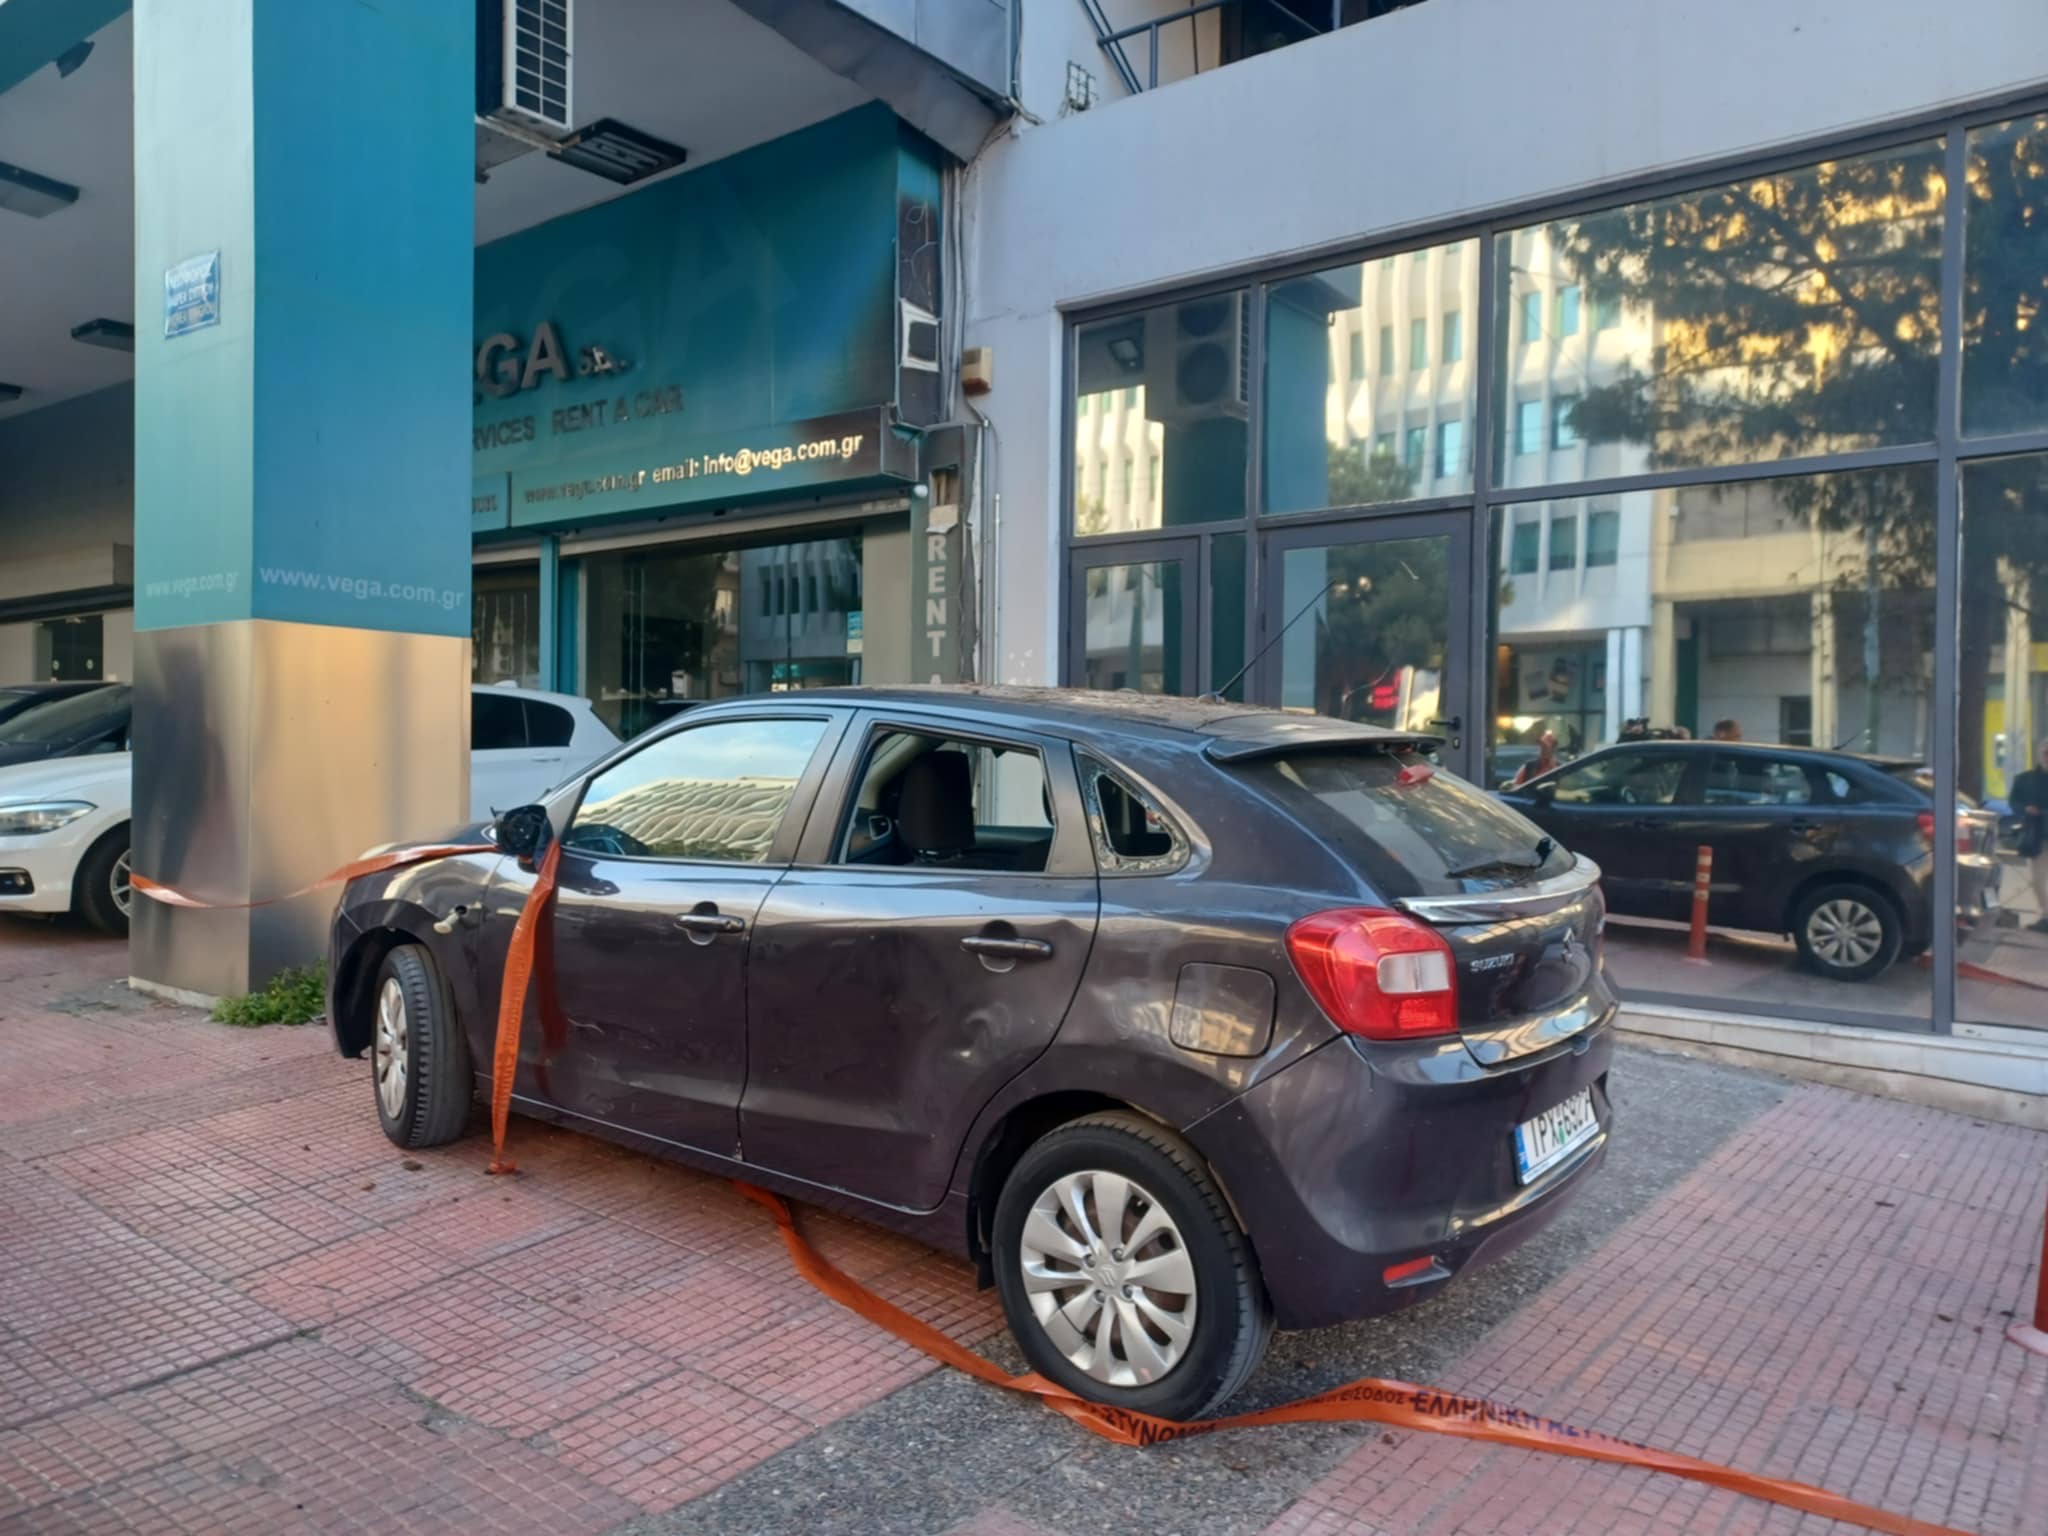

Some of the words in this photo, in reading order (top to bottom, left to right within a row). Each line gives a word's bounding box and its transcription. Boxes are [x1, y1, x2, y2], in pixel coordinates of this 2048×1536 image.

[474, 319, 567, 399] GA
[551, 399, 607, 435] RENT
[652, 457, 700, 483] email:
[703, 434, 863, 475] info@vega.com.gr
[259, 565, 464, 610] www.vega.com.gr
[926, 534, 947, 657] RENT
